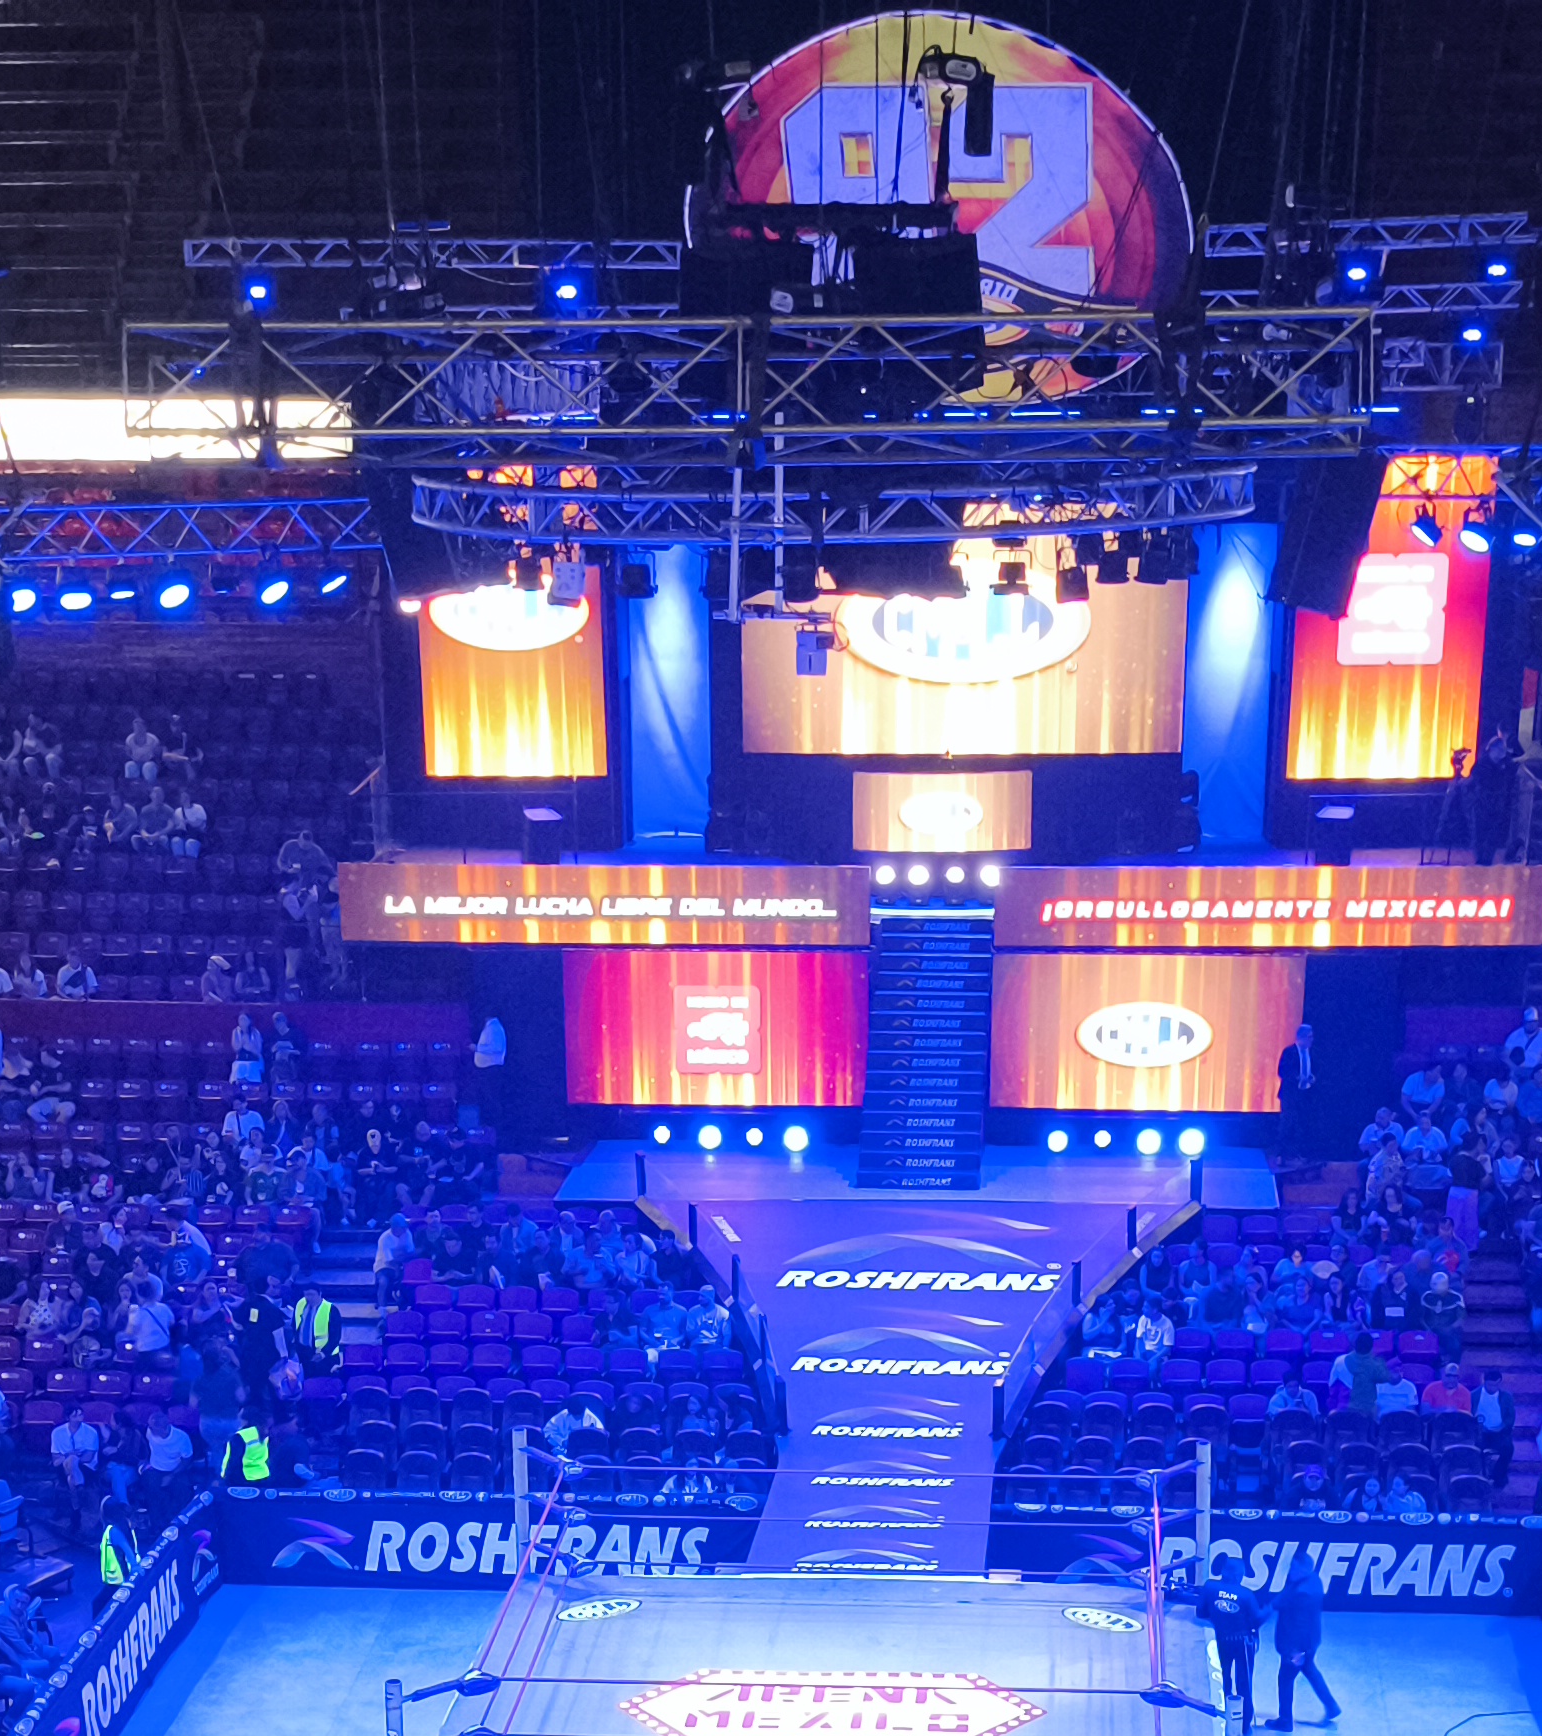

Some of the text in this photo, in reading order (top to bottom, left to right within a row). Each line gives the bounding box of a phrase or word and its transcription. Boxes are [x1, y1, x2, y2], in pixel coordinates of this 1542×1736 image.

[384, 895, 416, 914] LA
[424, 896, 507, 915] MEJOR
[515, 896, 593, 917] LUCHA
[601, 897, 672, 917] LIBRE
[679, 897, 725, 917] DEL
[905, 1158, 955, 1168] ROSHFRANS
[902, 1177, 952, 1186] ROSHFRANS
[776, 1269, 1060, 1292] ROSHFRANS
[791, 1356, 1009, 1376] ROSHFRANS
[811, 1425, 962, 1438] ROSHFRANS
[810, 1476, 955, 1487] ROSHFRANS
[365, 1520, 709, 1578] ROSHFRANS
